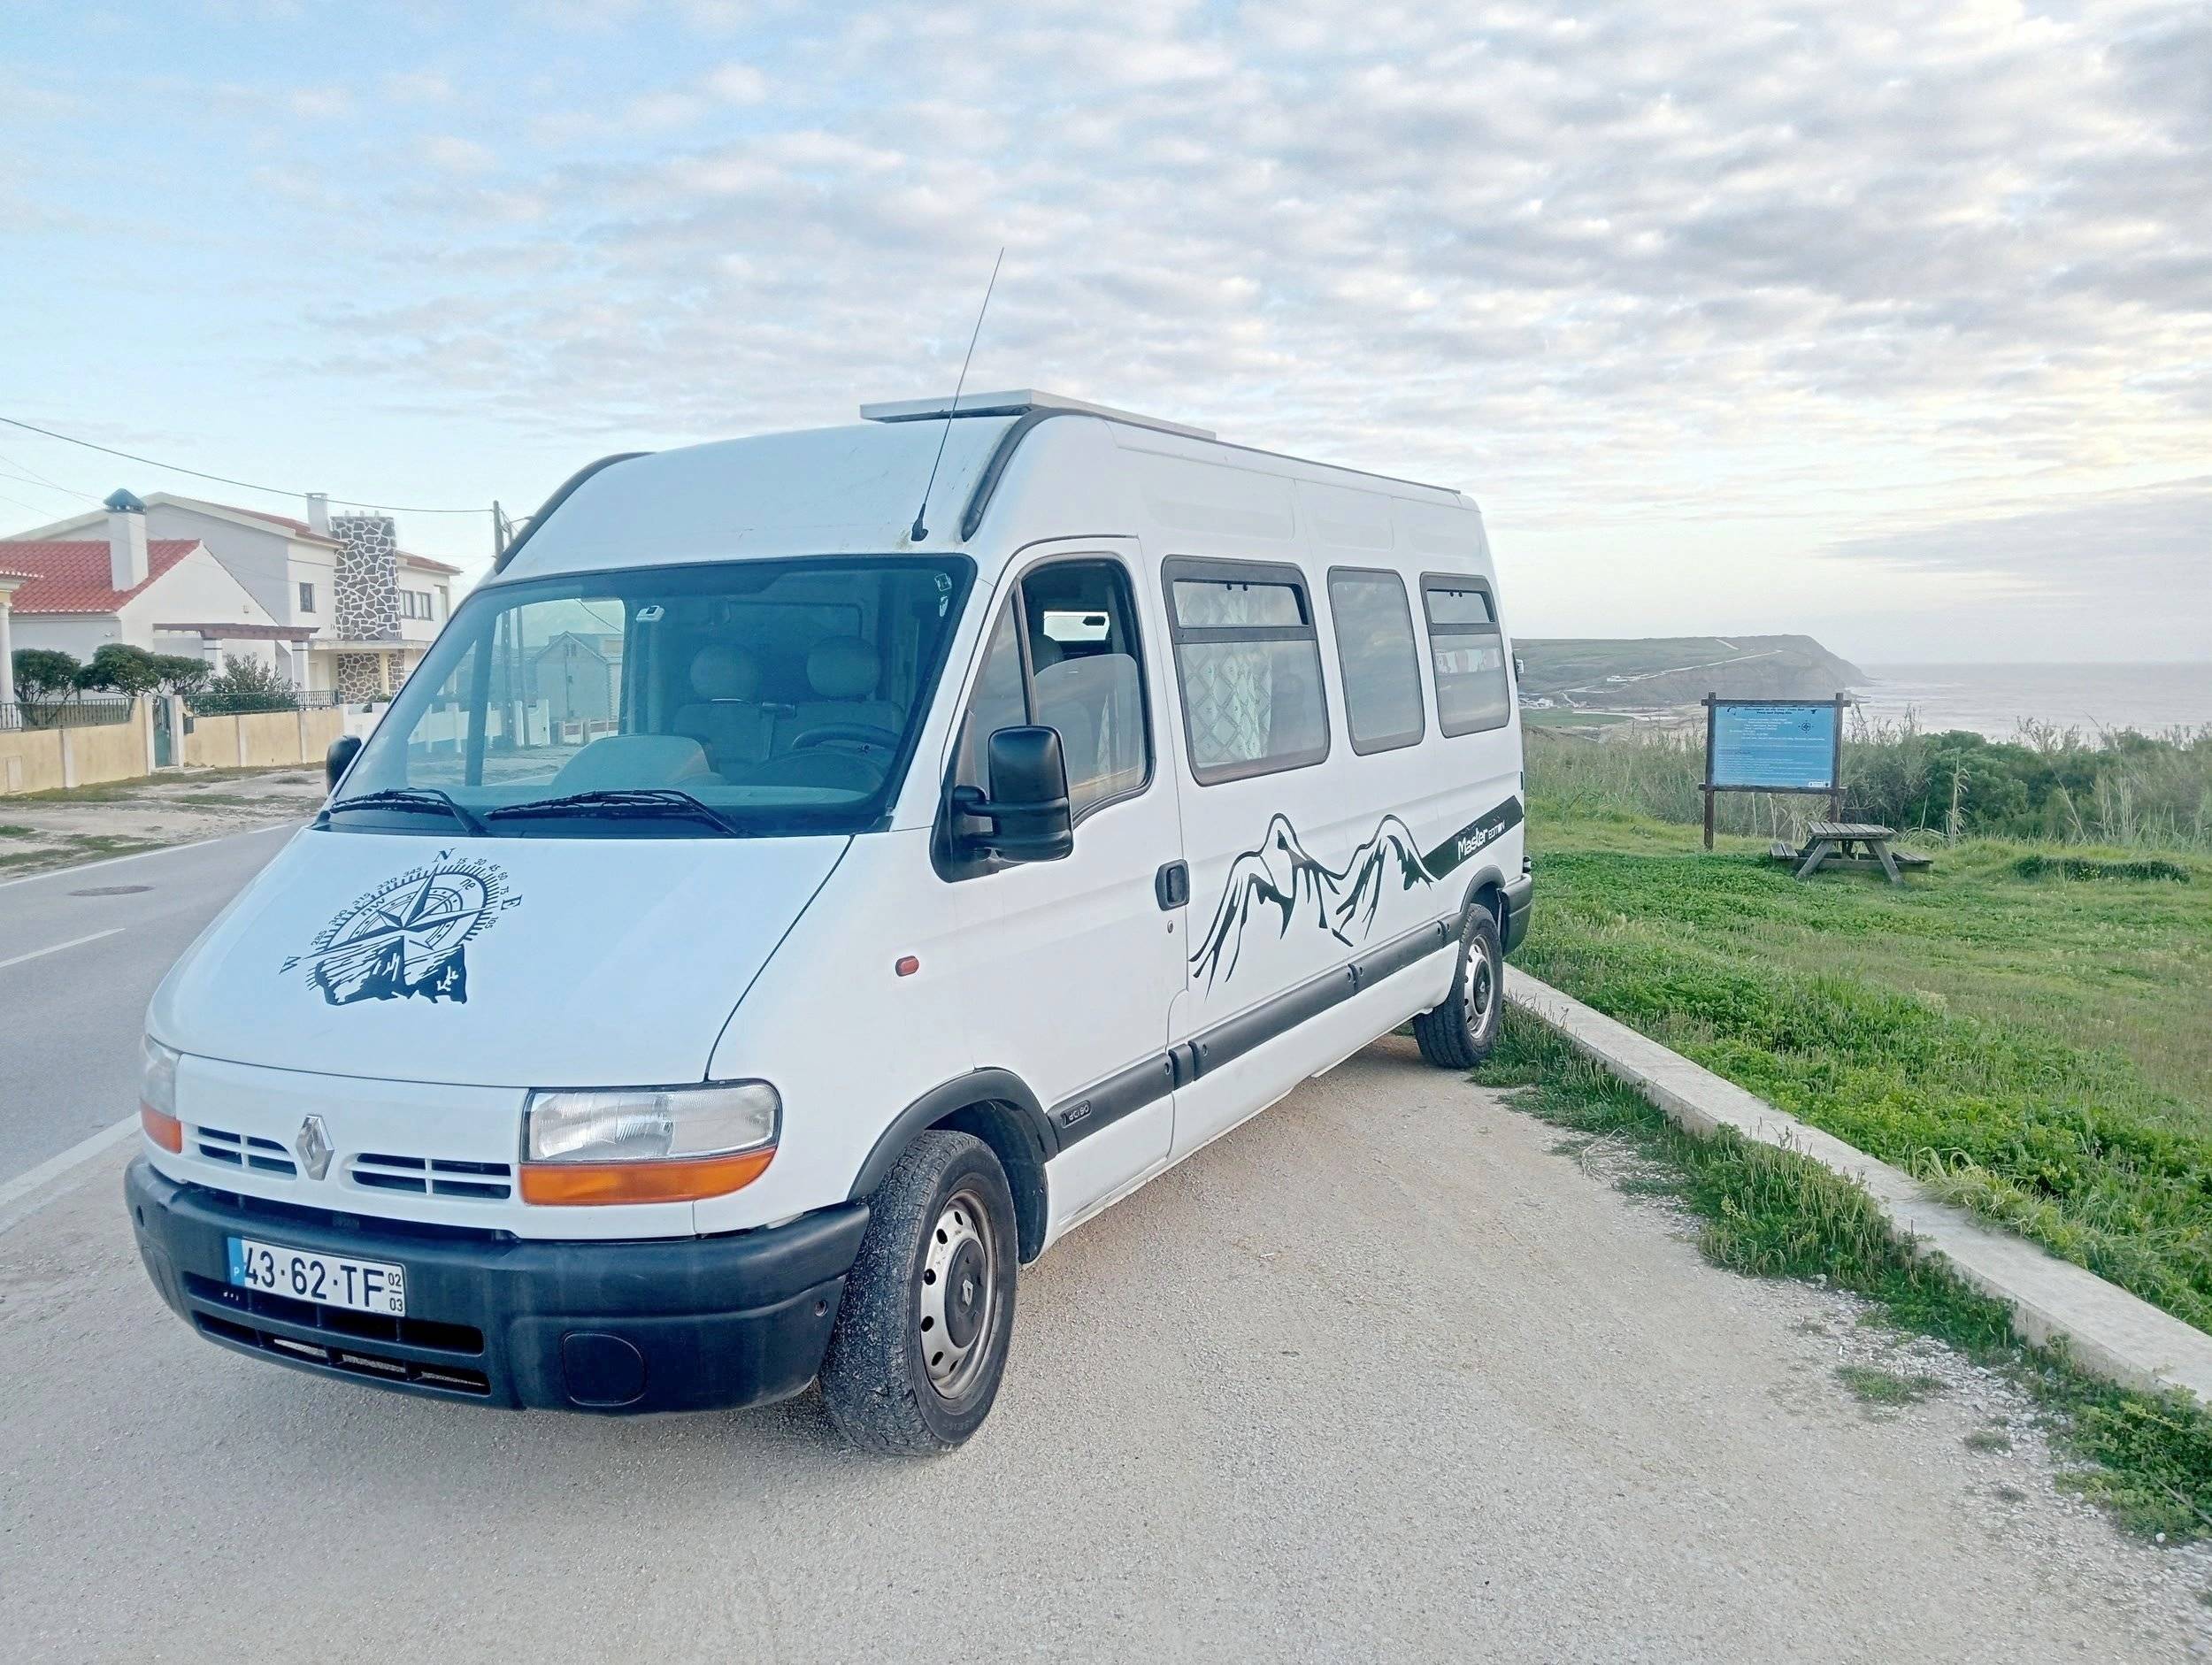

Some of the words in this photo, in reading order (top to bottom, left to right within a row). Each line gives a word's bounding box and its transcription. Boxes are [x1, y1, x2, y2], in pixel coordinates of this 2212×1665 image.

[1457, 827, 1488, 861] Master
[432, 848, 456, 863] N
[234, 1266, 240, 1277] P
[388, 1272, 403, 1287] 02
[389, 1297, 403, 1312] 03
